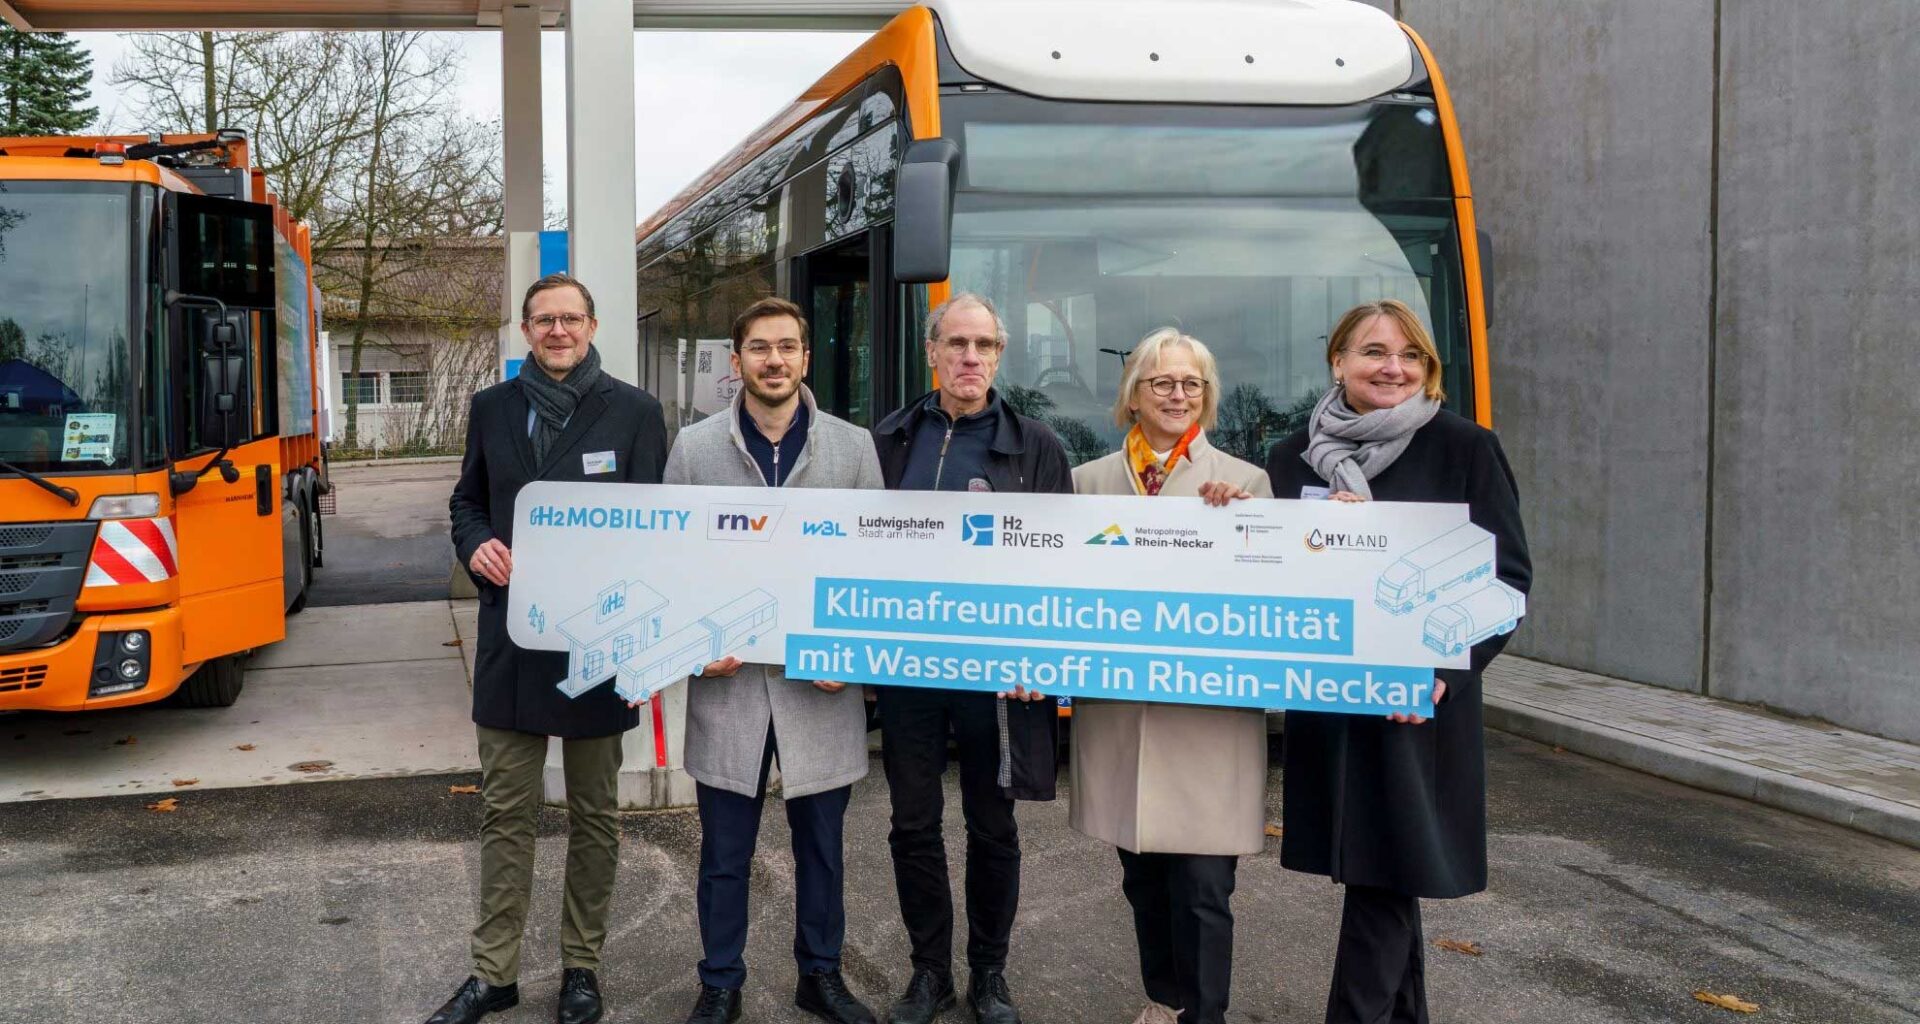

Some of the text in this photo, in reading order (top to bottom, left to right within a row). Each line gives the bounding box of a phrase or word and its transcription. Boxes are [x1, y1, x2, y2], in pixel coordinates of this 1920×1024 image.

[717, 513, 768, 532] rnv
[858, 516, 944, 531] Ludwigshafen
[1003, 516, 1022, 530] H2
[858, 528, 935, 540] Stadt am Rhein
[1135, 527, 1198, 537] Metropolregion
[1002, 533, 1064, 548] RIVERS
[1135, 536, 1214, 549] Rhein-Neckar
[1325, 534, 1388, 548] HYLAND
[827, 587, 1340, 641] Klimafreundliche Mobilität
[799, 642, 1427, 707] mit Wasserstoff in Rhein-Neckar
